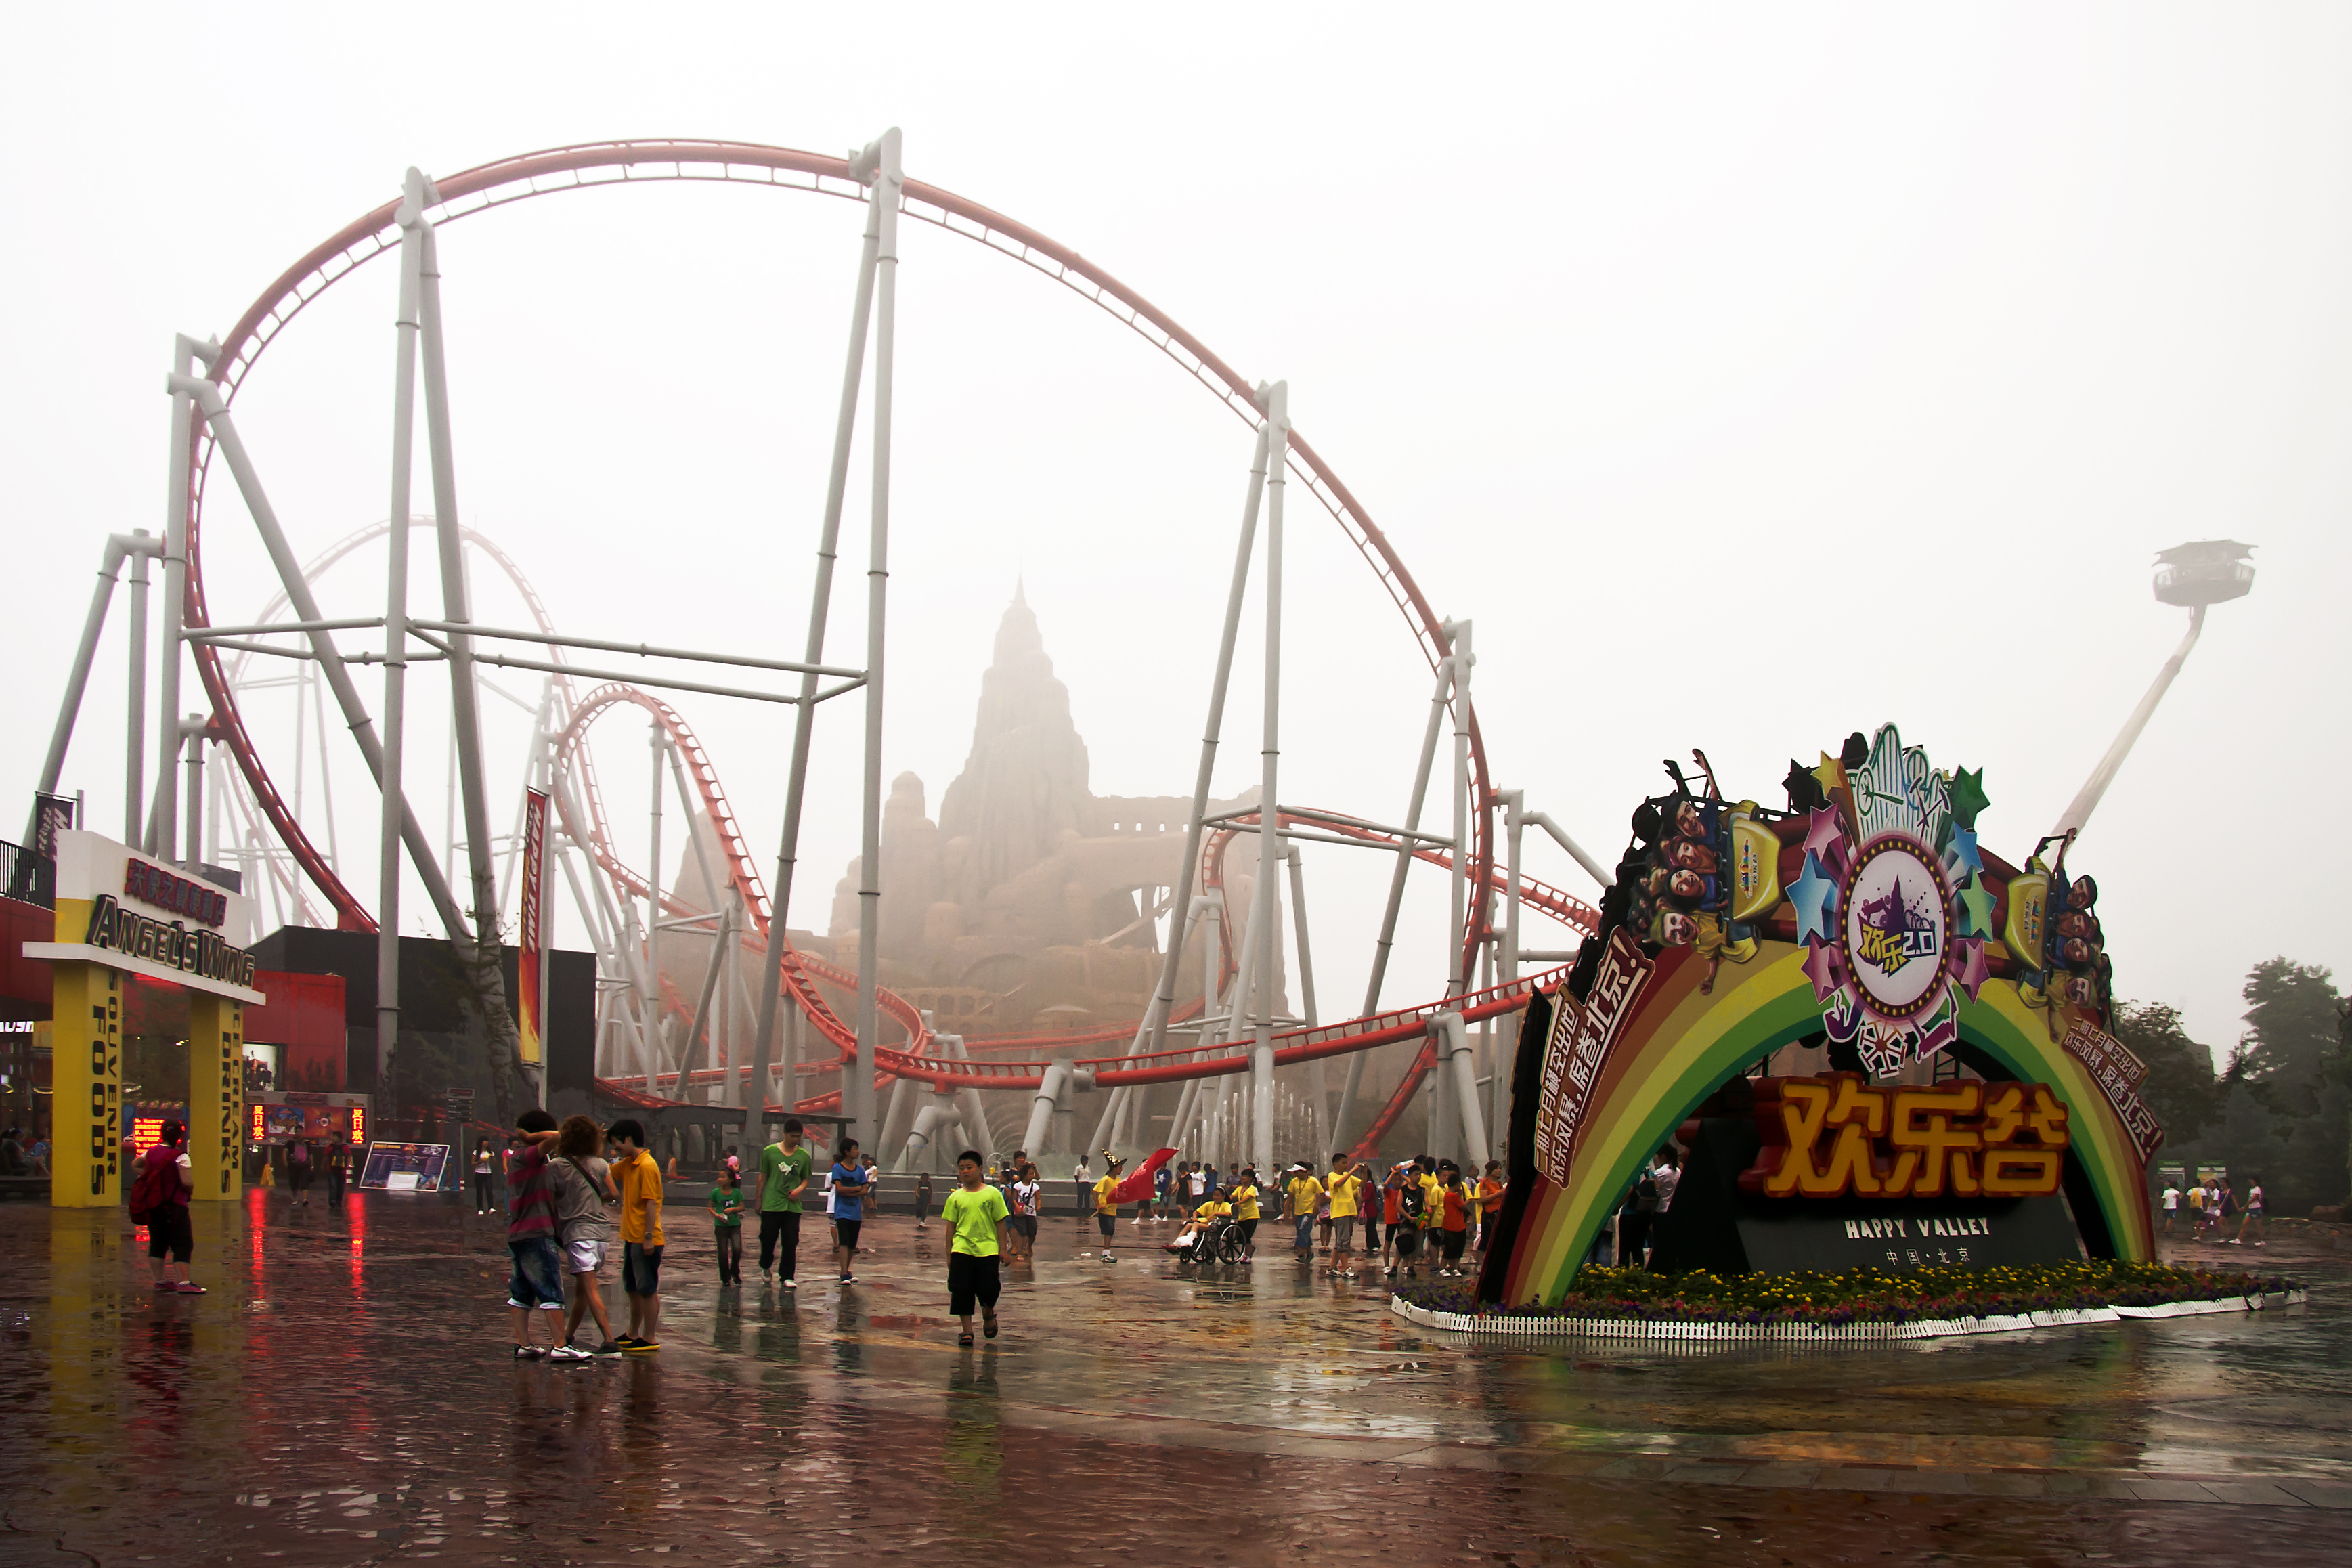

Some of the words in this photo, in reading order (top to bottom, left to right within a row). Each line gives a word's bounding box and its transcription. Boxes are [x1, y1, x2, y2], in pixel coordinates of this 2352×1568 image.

[528, 803, 542, 893] HAPPY
[88, 894, 198, 972] ANGEL'S
[195, 929, 255, 988] WING
[91, 1005, 107, 1196] FOODS
[107, 969, 118, 1176] SOUVENIR
[221, 1032, 232, 1194] DRINKS
[231, 1059, 240, 1169] CREAM
[253, 1105, 265, 1140] 夏日欢
[351, 1108, 364, 1144] 夏日欢
[1764, 1077, 2069, 1195] 欢乐谷
[1844, 1219, 1907, 1239] HAPPY
[1917, 1217, 1990, 1238] VALLEY
